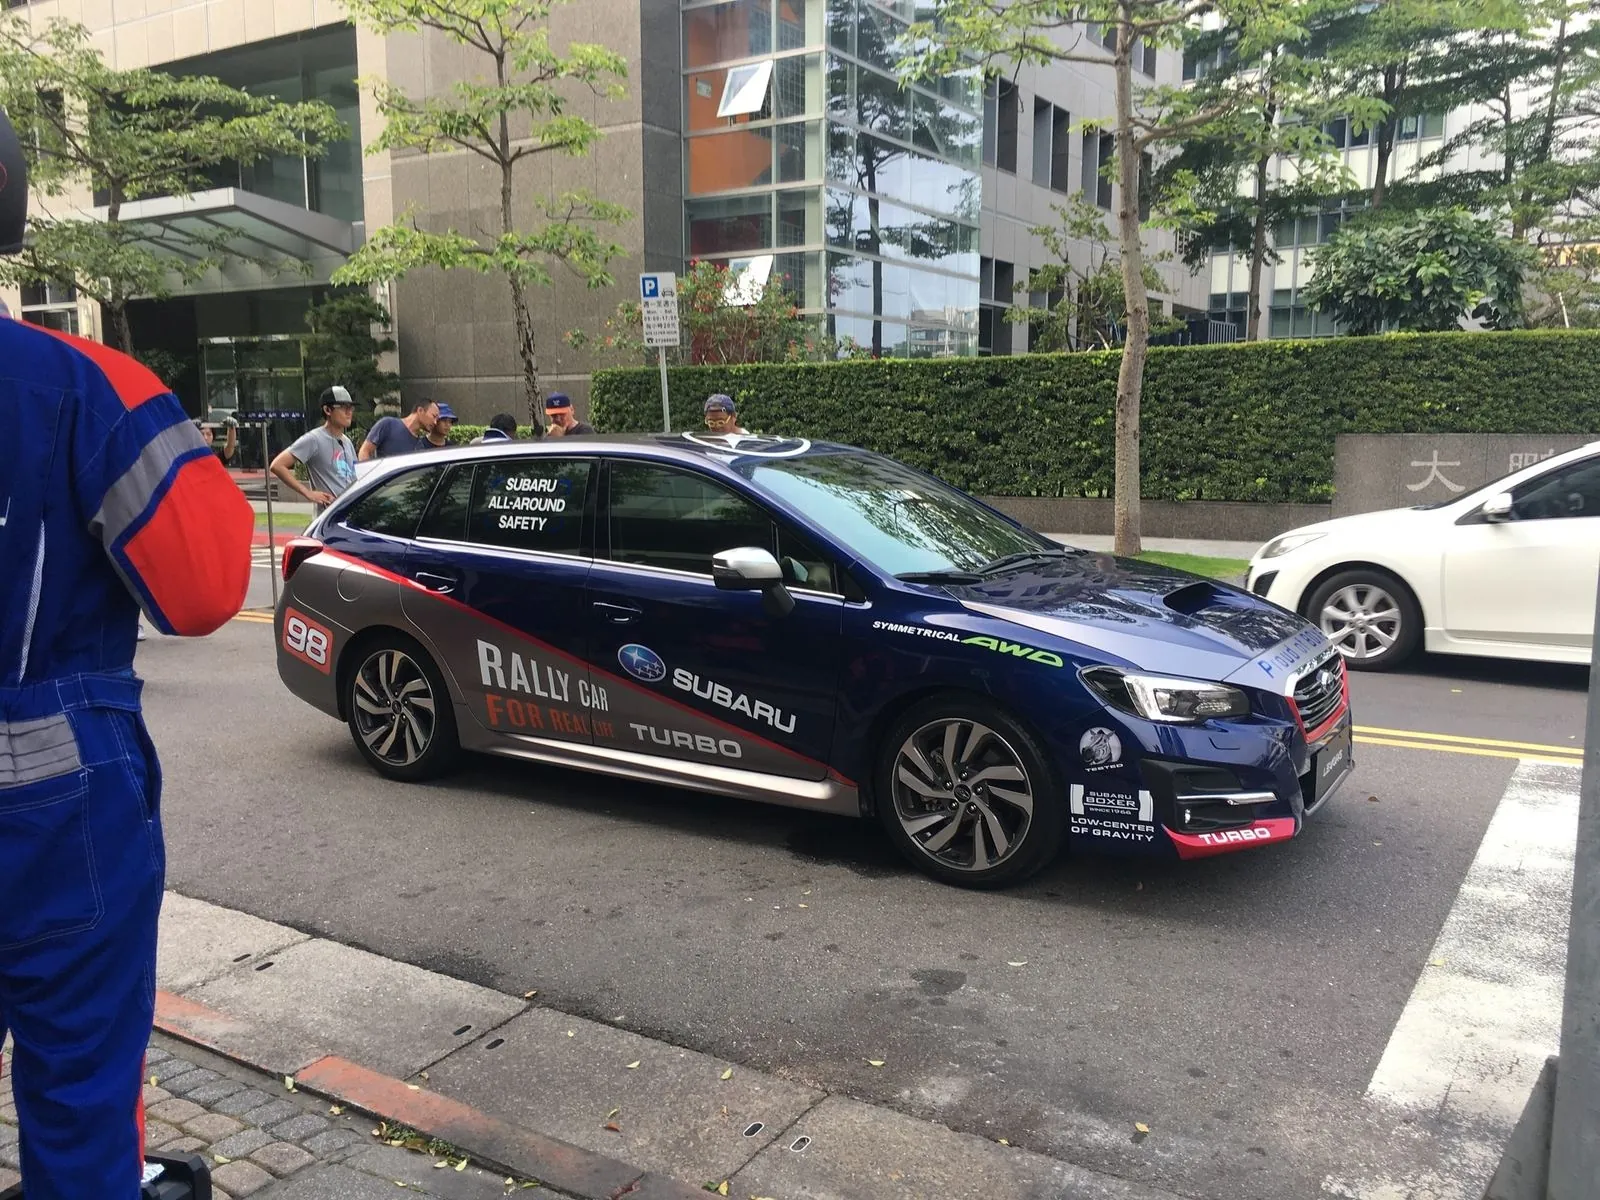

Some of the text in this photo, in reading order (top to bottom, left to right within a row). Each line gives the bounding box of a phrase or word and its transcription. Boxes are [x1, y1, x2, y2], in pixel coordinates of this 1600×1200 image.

[645, 280, 655, 295] P
[505, 477, 558, 493] SUBARU
[488, 495, 566, 512] ALL-AROUND
[498, 515, 547, 531] SAFETY
[286, 616, 328, 665] 98
[872, 620, 1064, 667] SYMMETRICAL AWD
[1257, 645, 1300, 679] Proud
[477, 638, 609, 712] RALLY CAR
[672, 668, 797, 734] SUBARU
[486, 693, 545, 730] FOR
[549, 708, 592, 735] REAL
[629, 722, 742, 758] TURBO
[1085, 763, 1124, 772] TESTED
[1086, 796, 1136, 807] BOXER
[1089, 791, 1132, 800] SUBARU
[1071, 817, 1155, 833] LOW-CENTER
[1071, 826, 1154, 842] OF GRAVITY
[1198, 827, 1271, 845] TURBO
